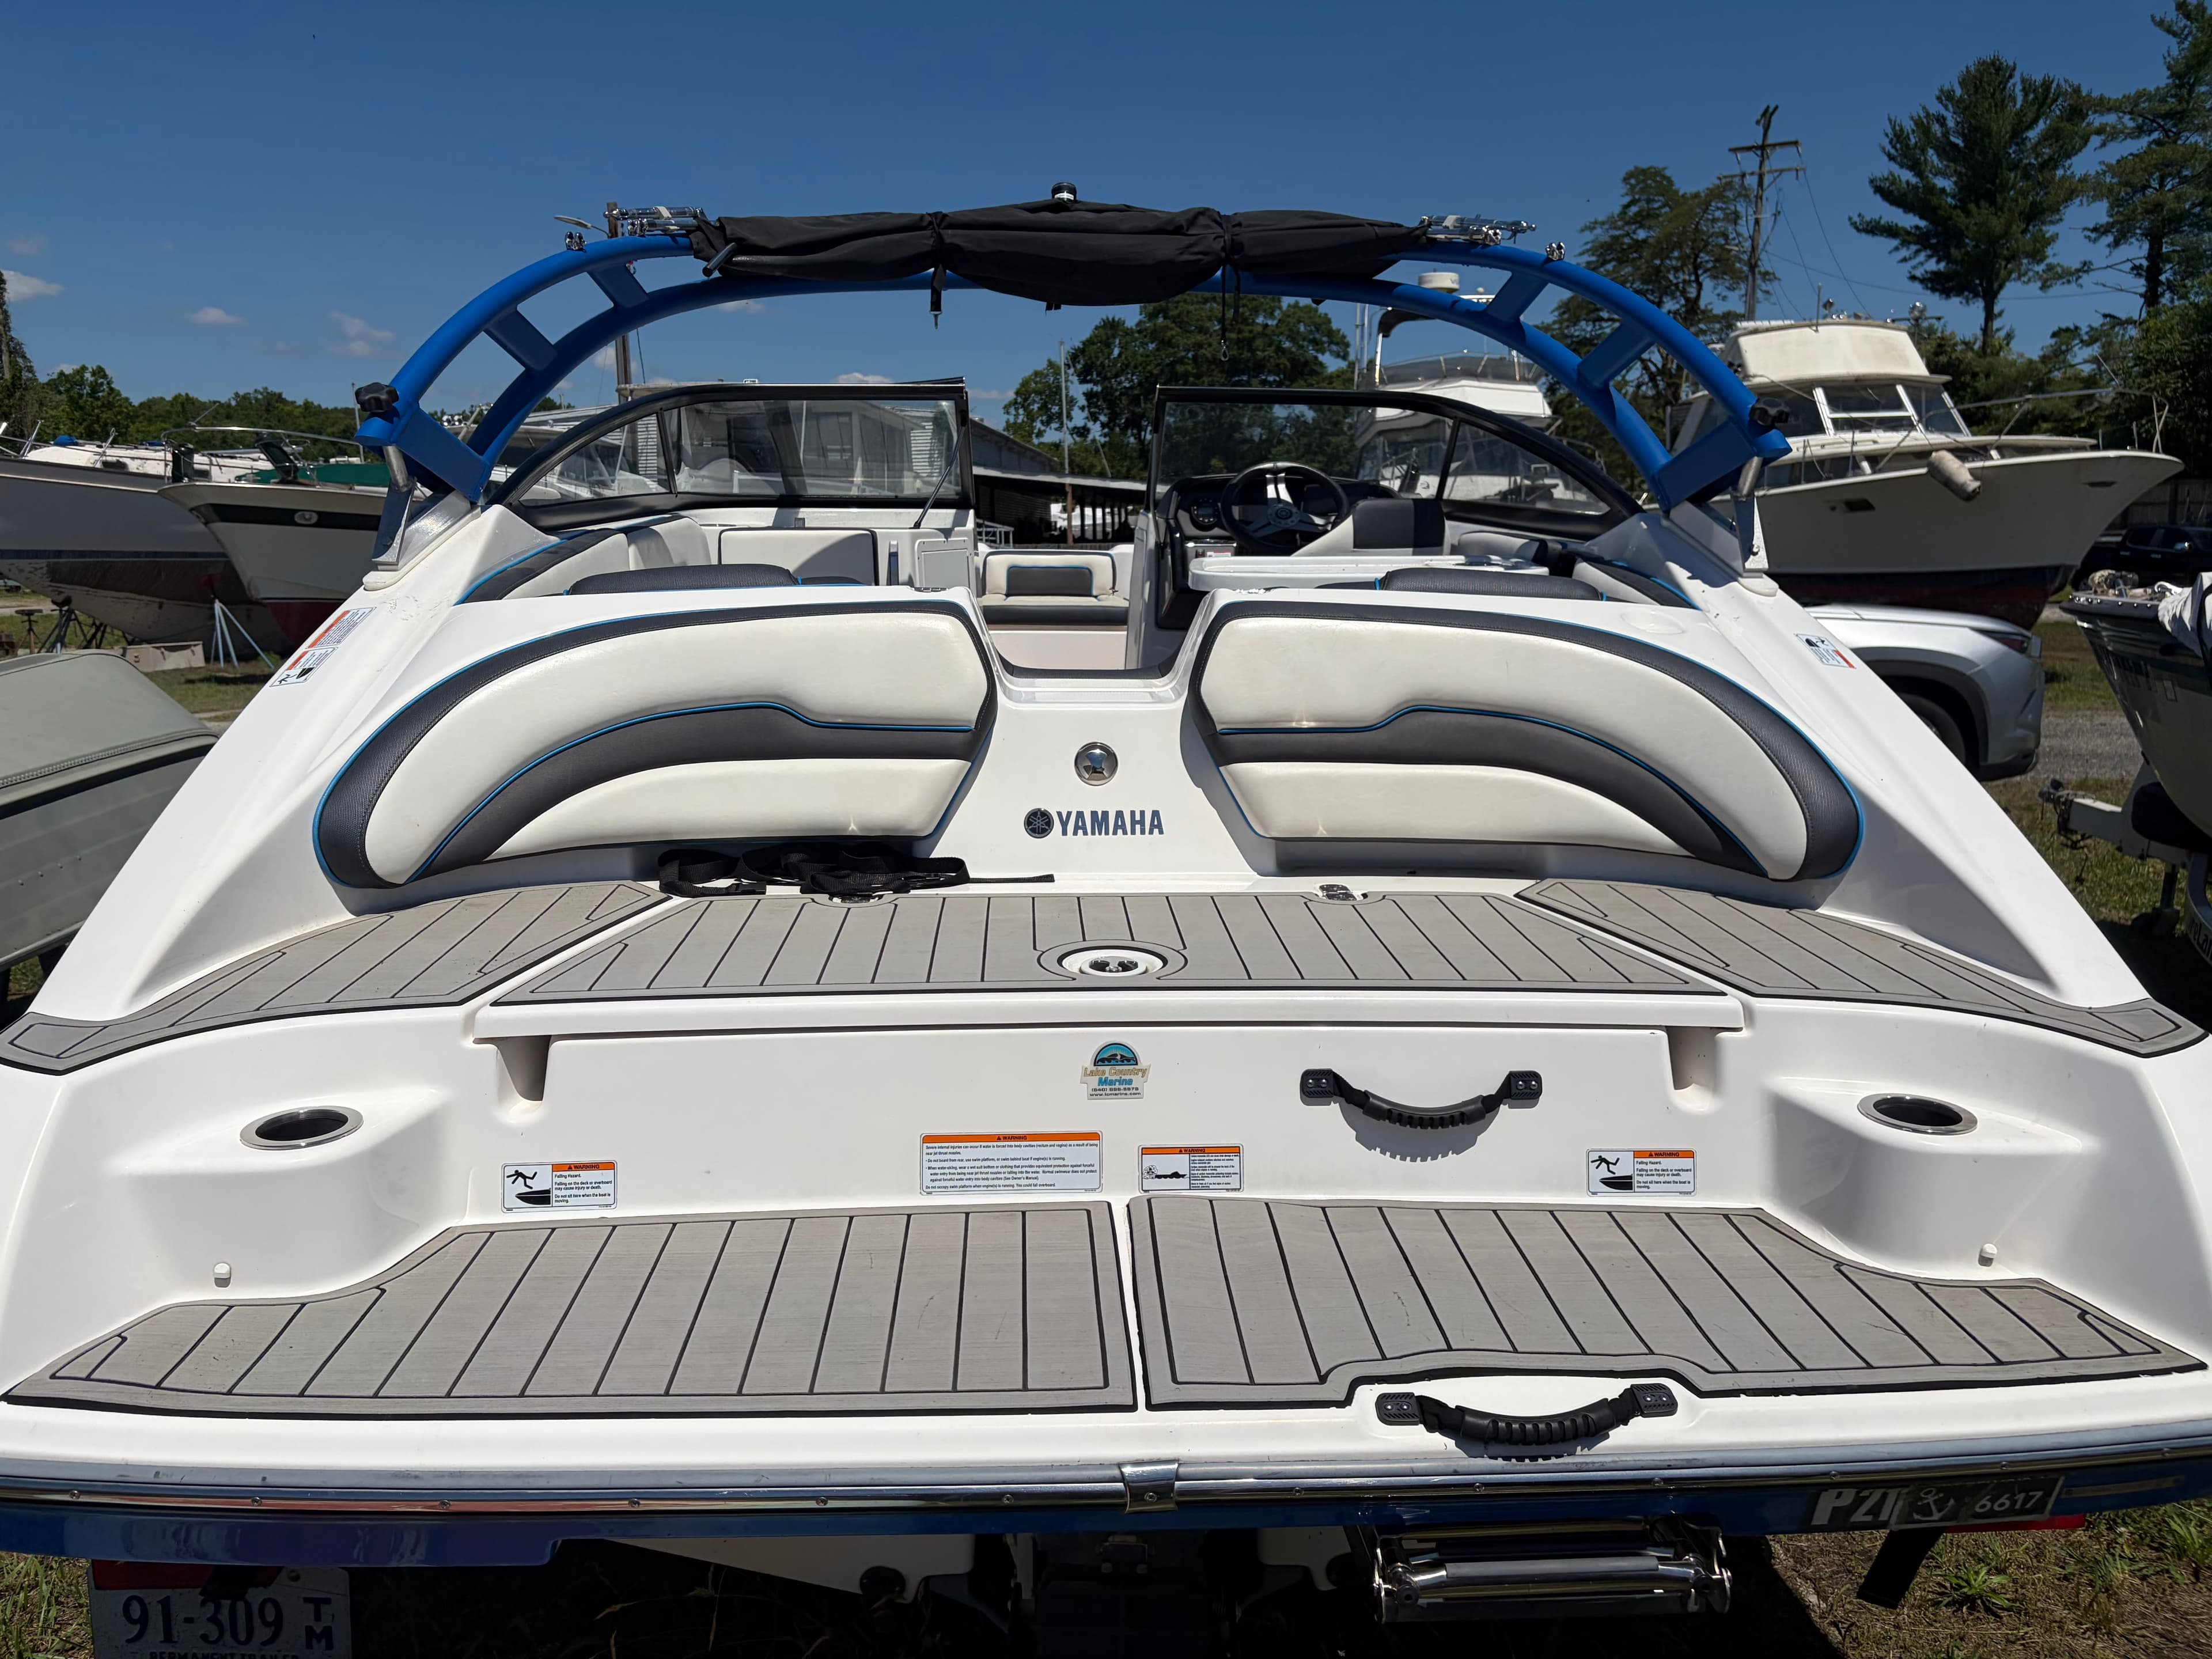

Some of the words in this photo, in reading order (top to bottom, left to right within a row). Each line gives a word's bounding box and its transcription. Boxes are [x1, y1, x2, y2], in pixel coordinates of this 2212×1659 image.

[1056, 810, 1164, 836] YAMAHA
[1084, 1067, 1106, 1077] Lake
[1109, 1067, 1147, 1078] Country
[1097, 1076, 1133, 1086] Marine
[1975, 1491, 2044, 1512] 6617
[122, 1595, 283, 1646] 91-309
